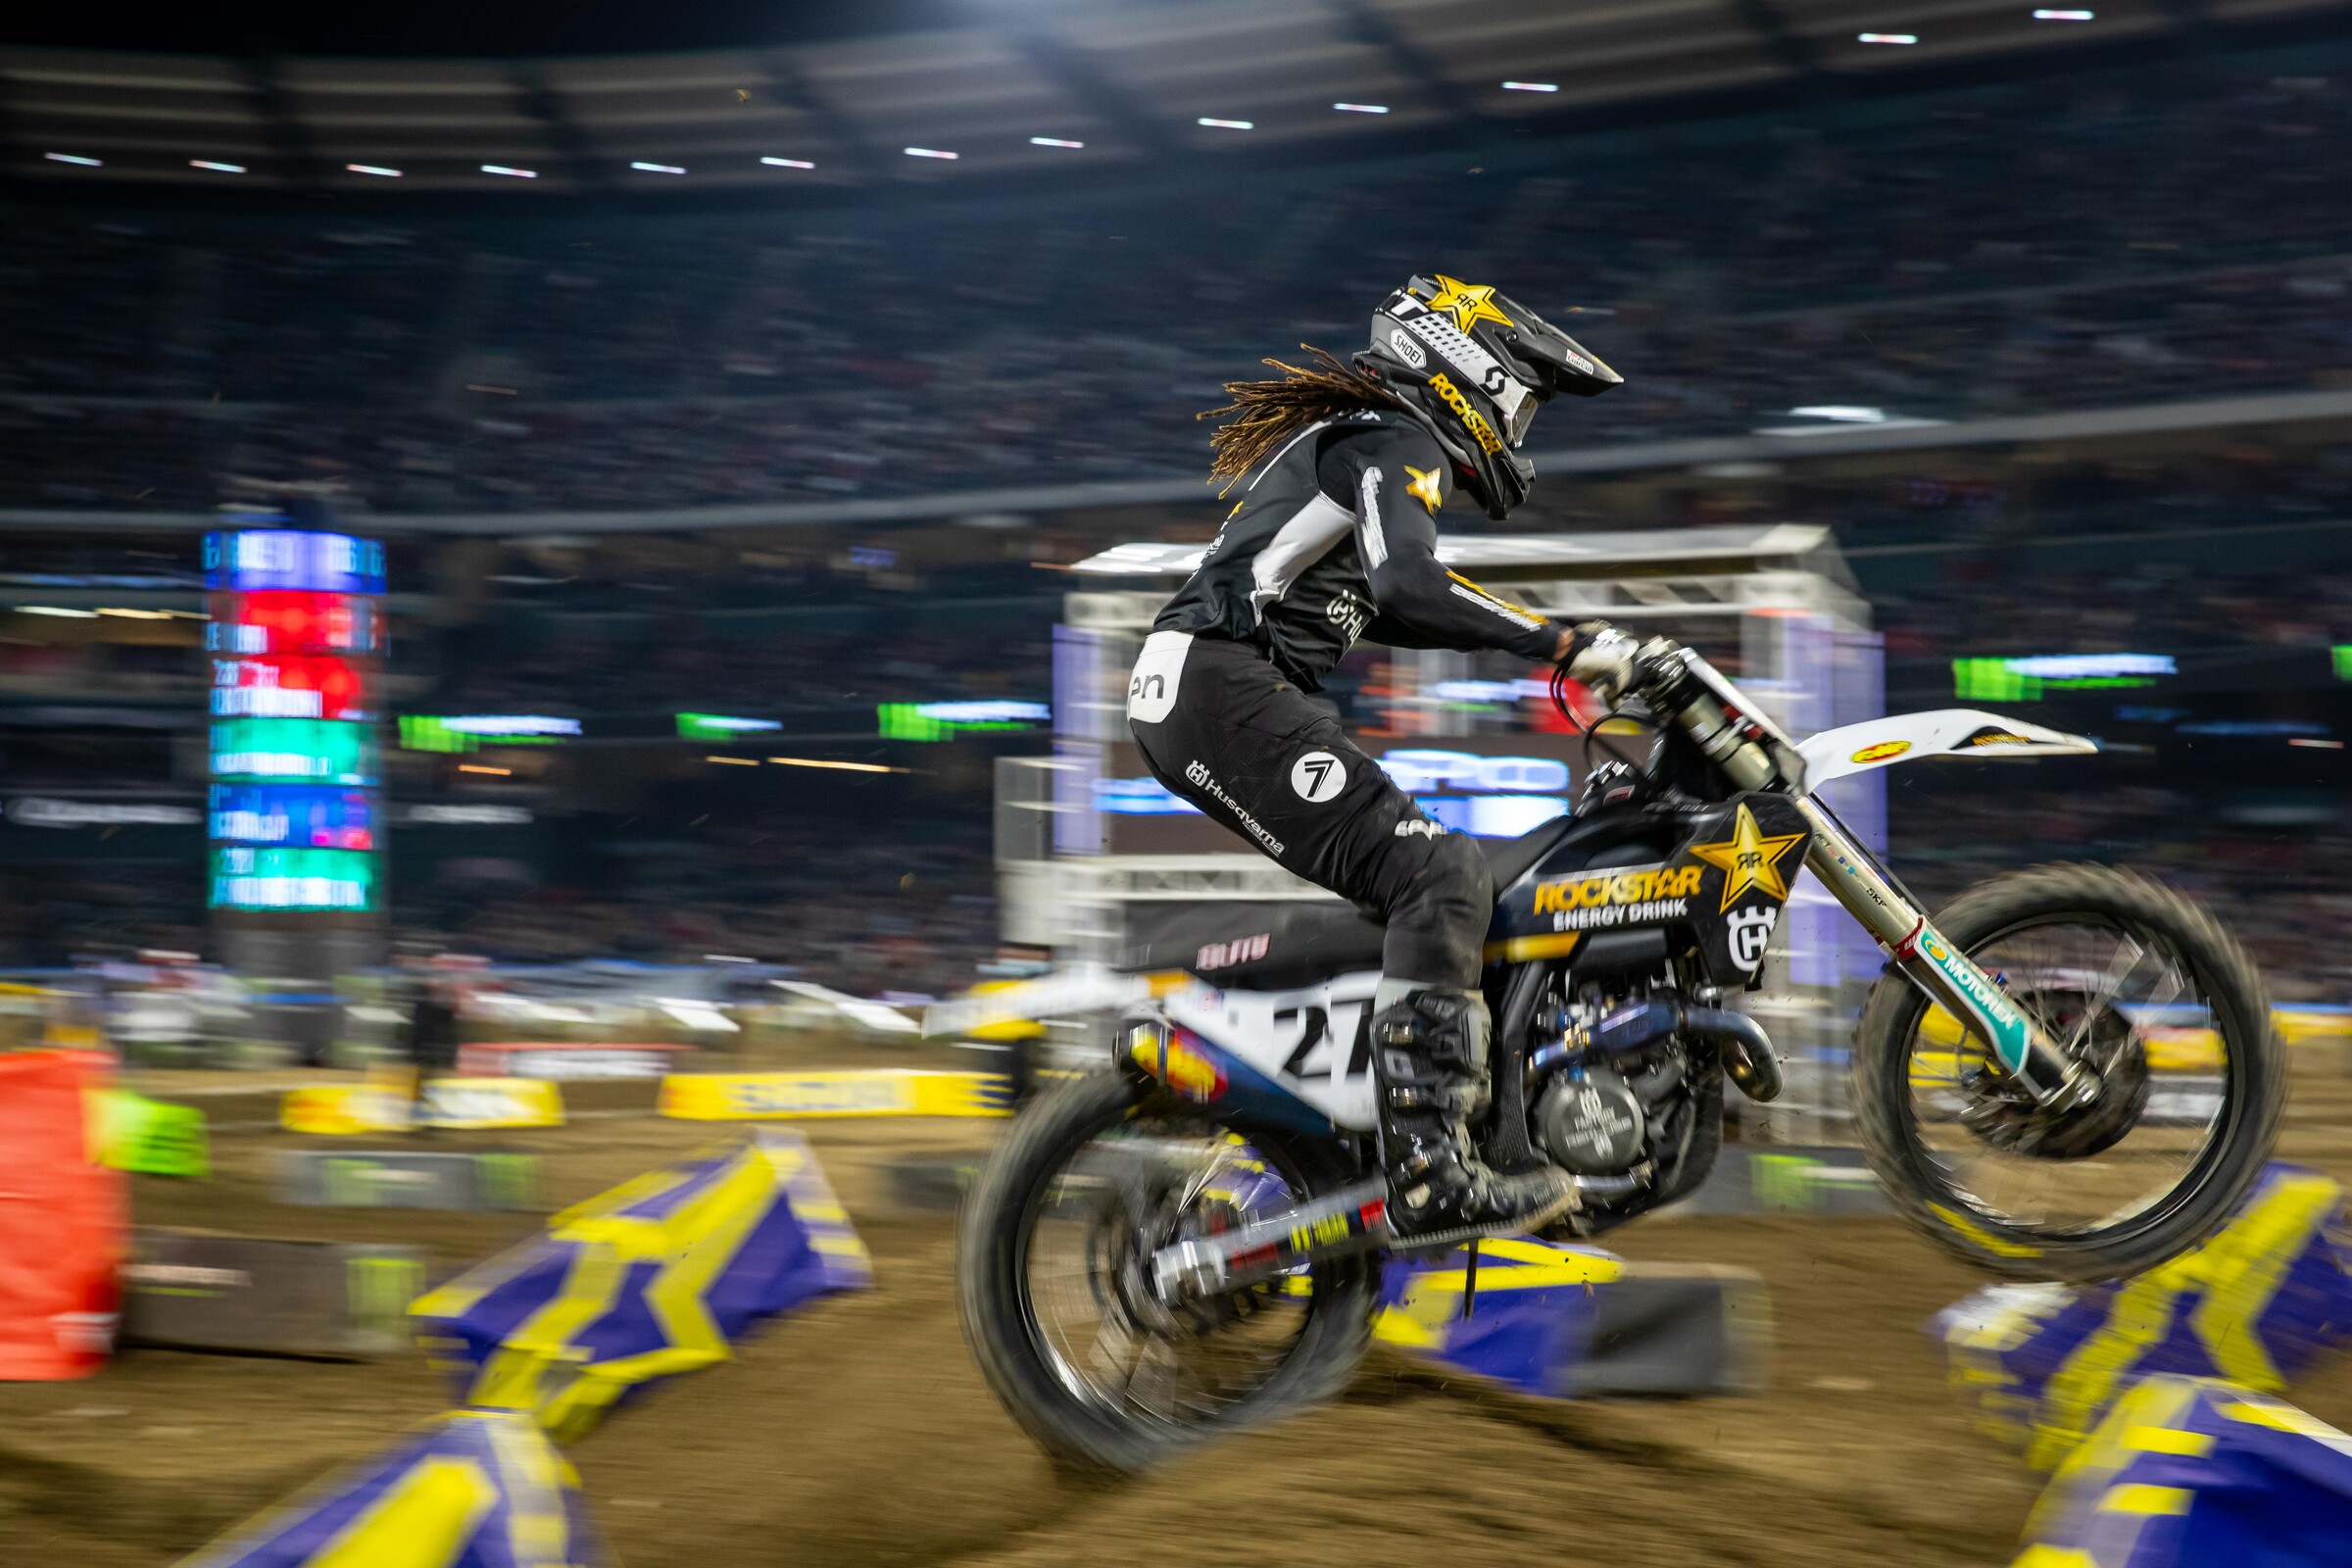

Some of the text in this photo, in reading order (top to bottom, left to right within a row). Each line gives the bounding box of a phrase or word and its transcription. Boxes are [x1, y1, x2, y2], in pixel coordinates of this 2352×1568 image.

[1394, 334, 1423, 365] SHOEI
[1428, 372, 1502, 456] ROCKSTAR
[1303, 759, 1336, 799] 7
[1204, 778, 1286, 855] Husqvarna
[1534, 864, 1705, 916] ROCKSTAR
[1553, 898, 1689, 932] ENERGY DRINK
[1865, 887, 1887, 907] SKF
[1943, 956, 2018, 1030] MOTOREX
[1273, 997, 1376, 1079] 27
